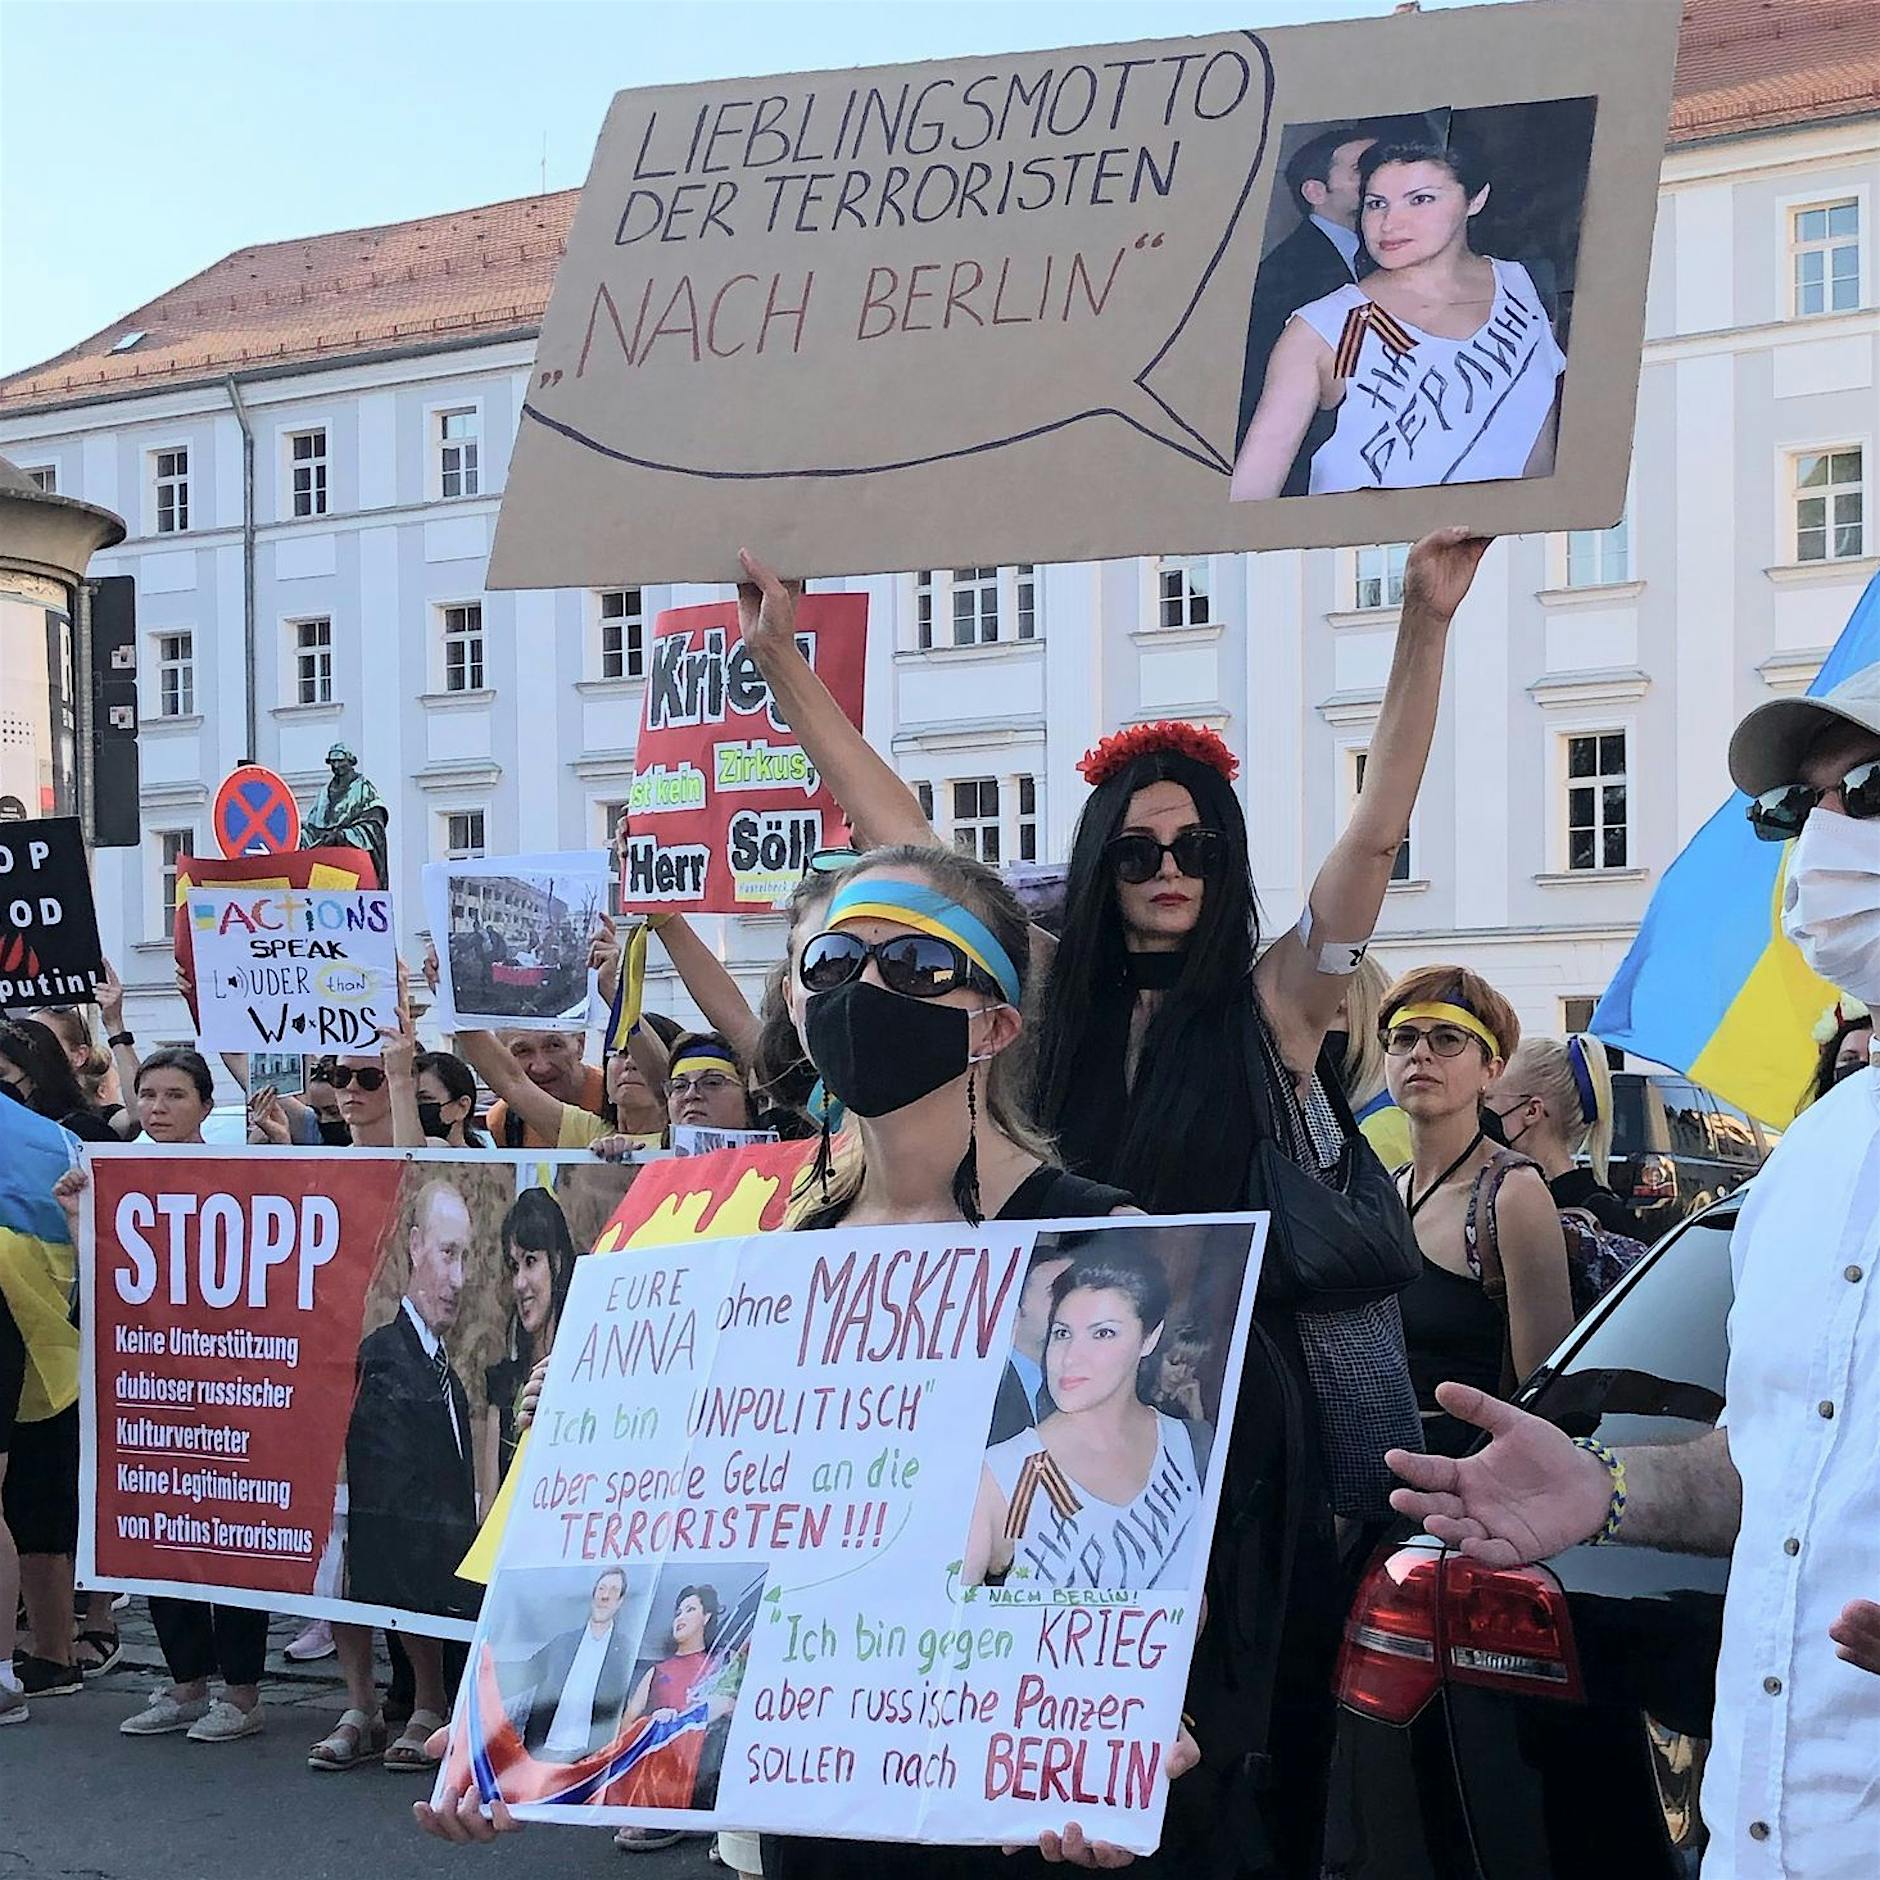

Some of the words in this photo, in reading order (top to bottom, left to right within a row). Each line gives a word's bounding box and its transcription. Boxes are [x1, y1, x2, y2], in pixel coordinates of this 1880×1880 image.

[633, 51, 1250, 181] LIEBLINGSMOTTO
[615, 181, 739, 246] DER
[765, 140, 1180, 232] TERRORISTEN
[656, 771, 701, 805] kein
[718, 748, 816, 787] Zirkus,
[630, 843, 705, 893] Herr
[250, 938, 348, 959] SPEAK
[114, 1191, 341, 1311] STOPP
[605, 1268, 690, 1313] EURE
[570, 1308, 696, 1383] ANNA
[716, 1283, 793, 1332] ohne
[797, 1246, 1022, 1368] MASKEN
[115, 1325, 165, 1355] Keine
[169, 1327, 299, 1368] Unterstützung
[115, 1371, 194, 1402] dubioser
[197, 1377, 294, 1408] russischer
[116, 1417, 250, 1454] Kulturvertreter
[613, 1403, 659, 1441] bin
[117, 1463, 169, 1494] Keine
[172, 1467, 291, 1509] Legitimierung
[533, 1465, 598, 1510] aber
[605, 1450, 705, 1511] spende
[723, 1449, 791, 1493] Geld
[812, 1460, 852, 1492] an
[868, 1447, 920, 1489] die
[117, 1515, 150, 1539] von
[153, 1512, 210, 1545] Putins
[211, 1518, 313, 1554] Terrorismus
[560, 1503, 832, 1560] TERRORISTEN
[990, 1589, 1041, 1602] NACH
[856, 1612, 906, 1662] bin
[917, 1628, 1014, 1675] gegen
[755, 1677, 834, 1722] aber
[851, 1680, 999, 1729] russische
[1013, 1674, 1145, 1732] Panzer
[882, 1743, 957, 1789] nach
[985, 1732, 1160, 1810] BERLIN
